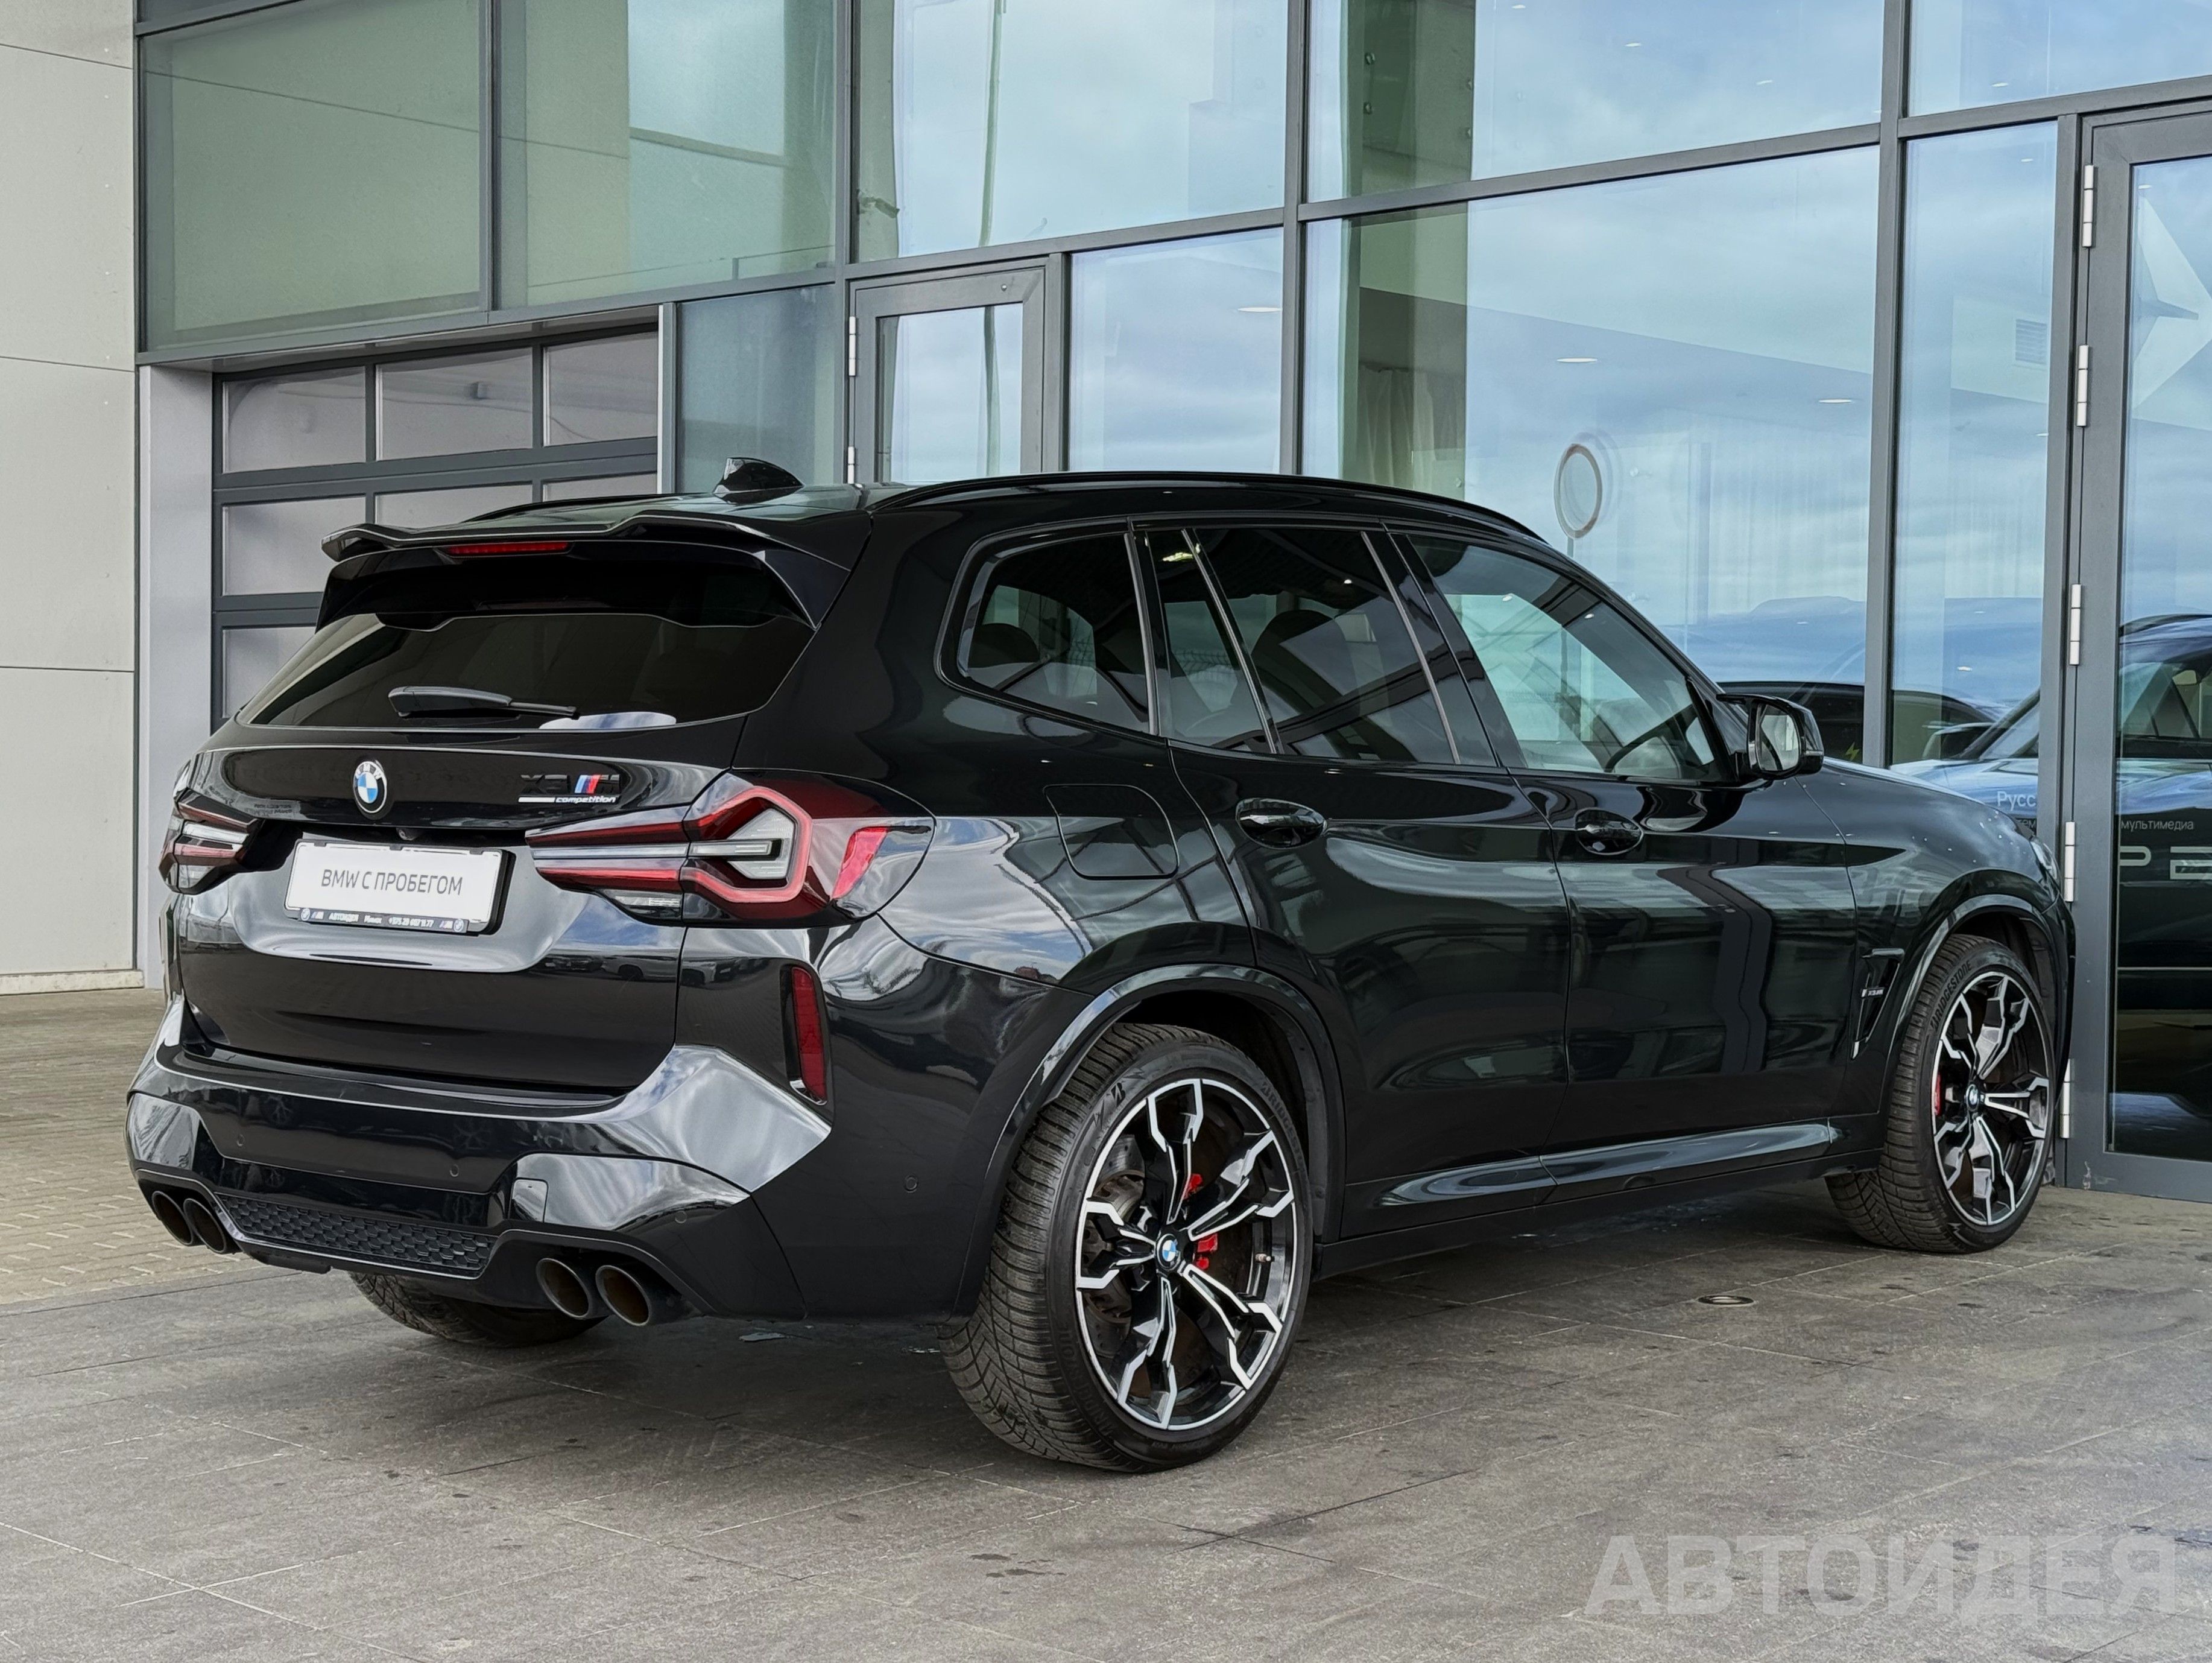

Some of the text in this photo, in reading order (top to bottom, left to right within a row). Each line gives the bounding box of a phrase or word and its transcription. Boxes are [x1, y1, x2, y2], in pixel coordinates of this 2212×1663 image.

[2120, 820, 2195, 832] мультимедиа
[321, 869, 361, 889] BMW
[374, 872, 463, 896] ПРОБЕГОМ
[1930, 960, 1972, 1031] BRIDGESTONE
